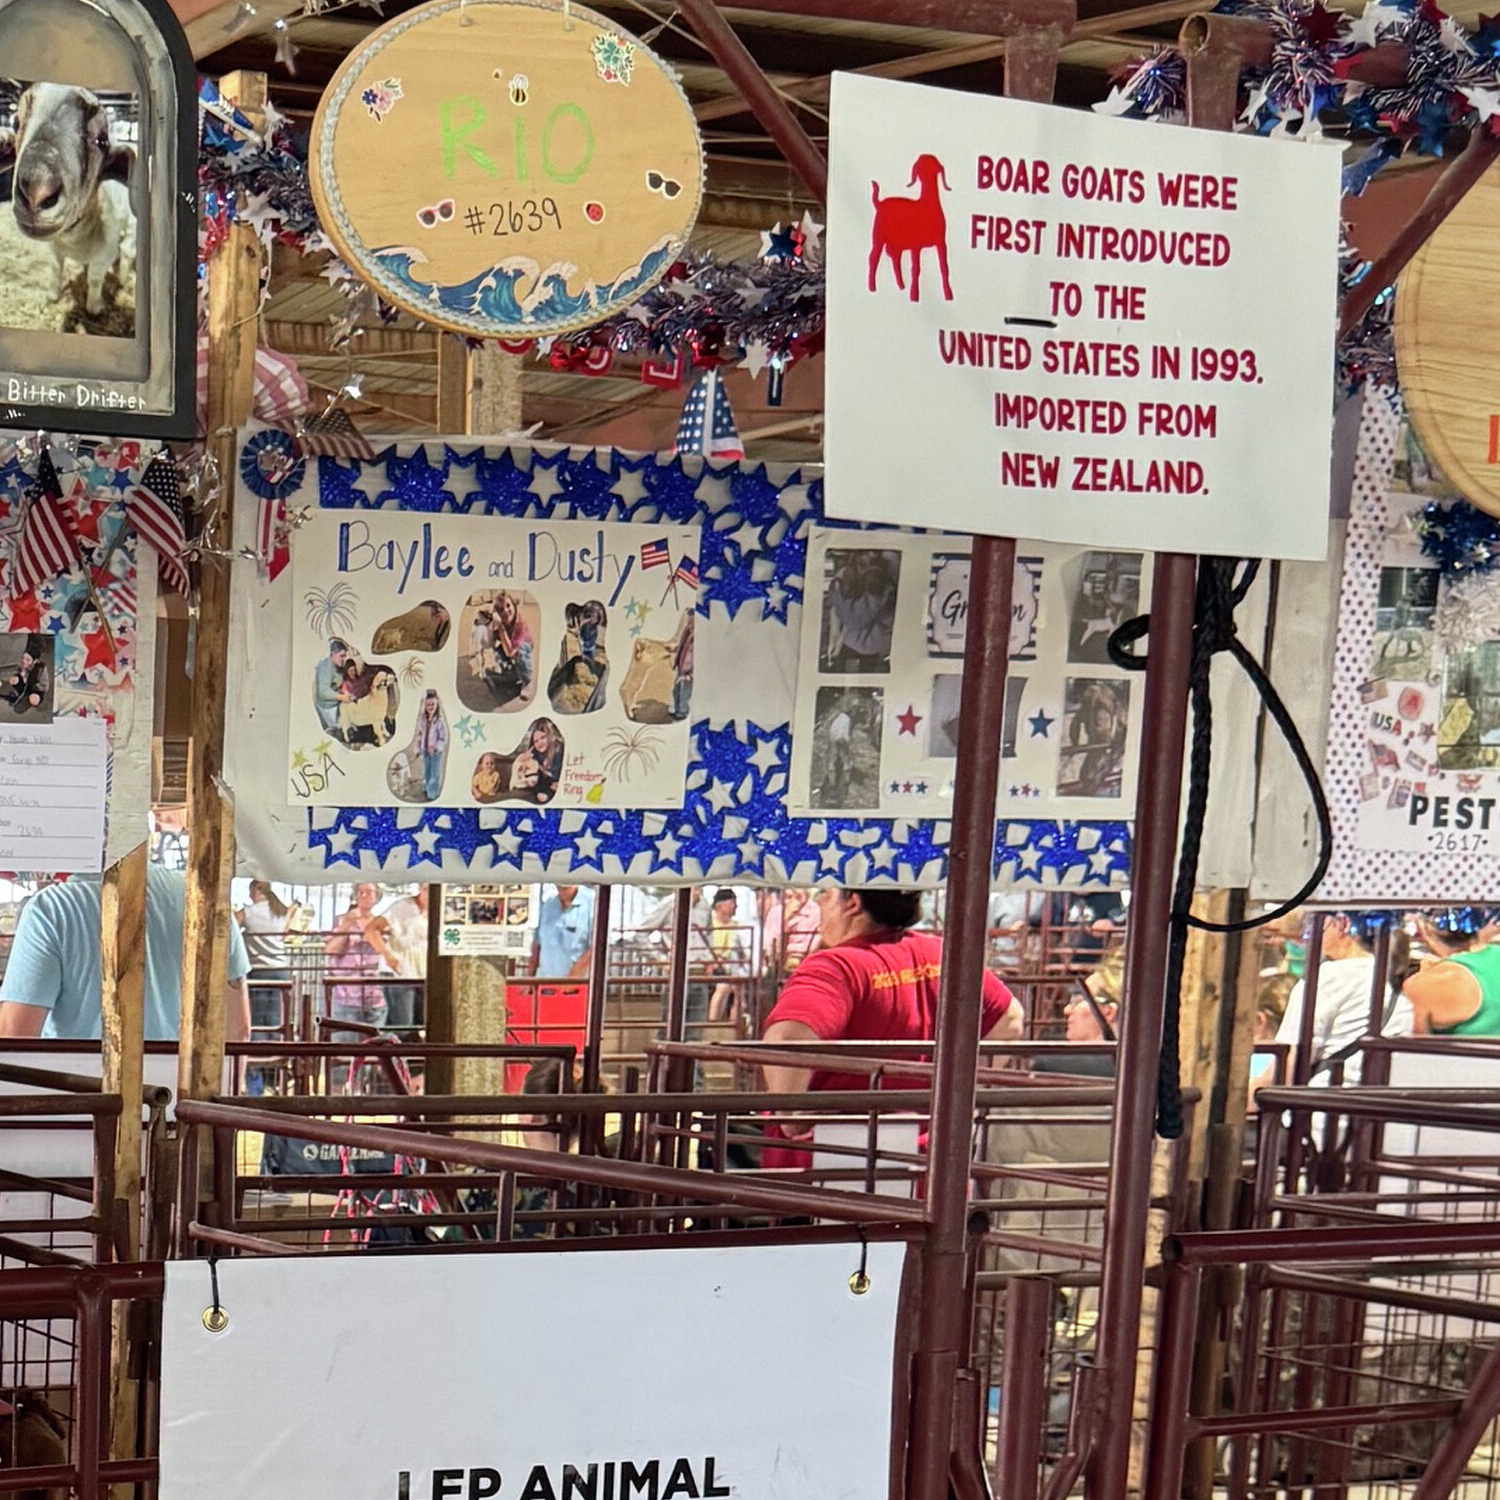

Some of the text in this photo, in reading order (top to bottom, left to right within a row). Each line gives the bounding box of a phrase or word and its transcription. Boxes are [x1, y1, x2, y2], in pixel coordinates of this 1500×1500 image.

[977, 155, 1238, 211] BOAR GOATS WERE
[464, 197, 562, 236] #2639
[971, 214, 1230, 267] FIRST INTRODUCED
[1050, 281, 1147, 320] TO THE
[939, 329, 1264, 384] UNITED STATES IN 1993.
[8, 378, 146, 411] Bitter Drifter
[994, 392, 1217, 438] IMPORTED FROM
[1001, 451, 1209, 495] NEW ZEALAND.
[338, 520, 635, 608] Baylee and Dusty
[291, 752, 345, 799] USA
[1434, 831, 1482, 852] 2617
